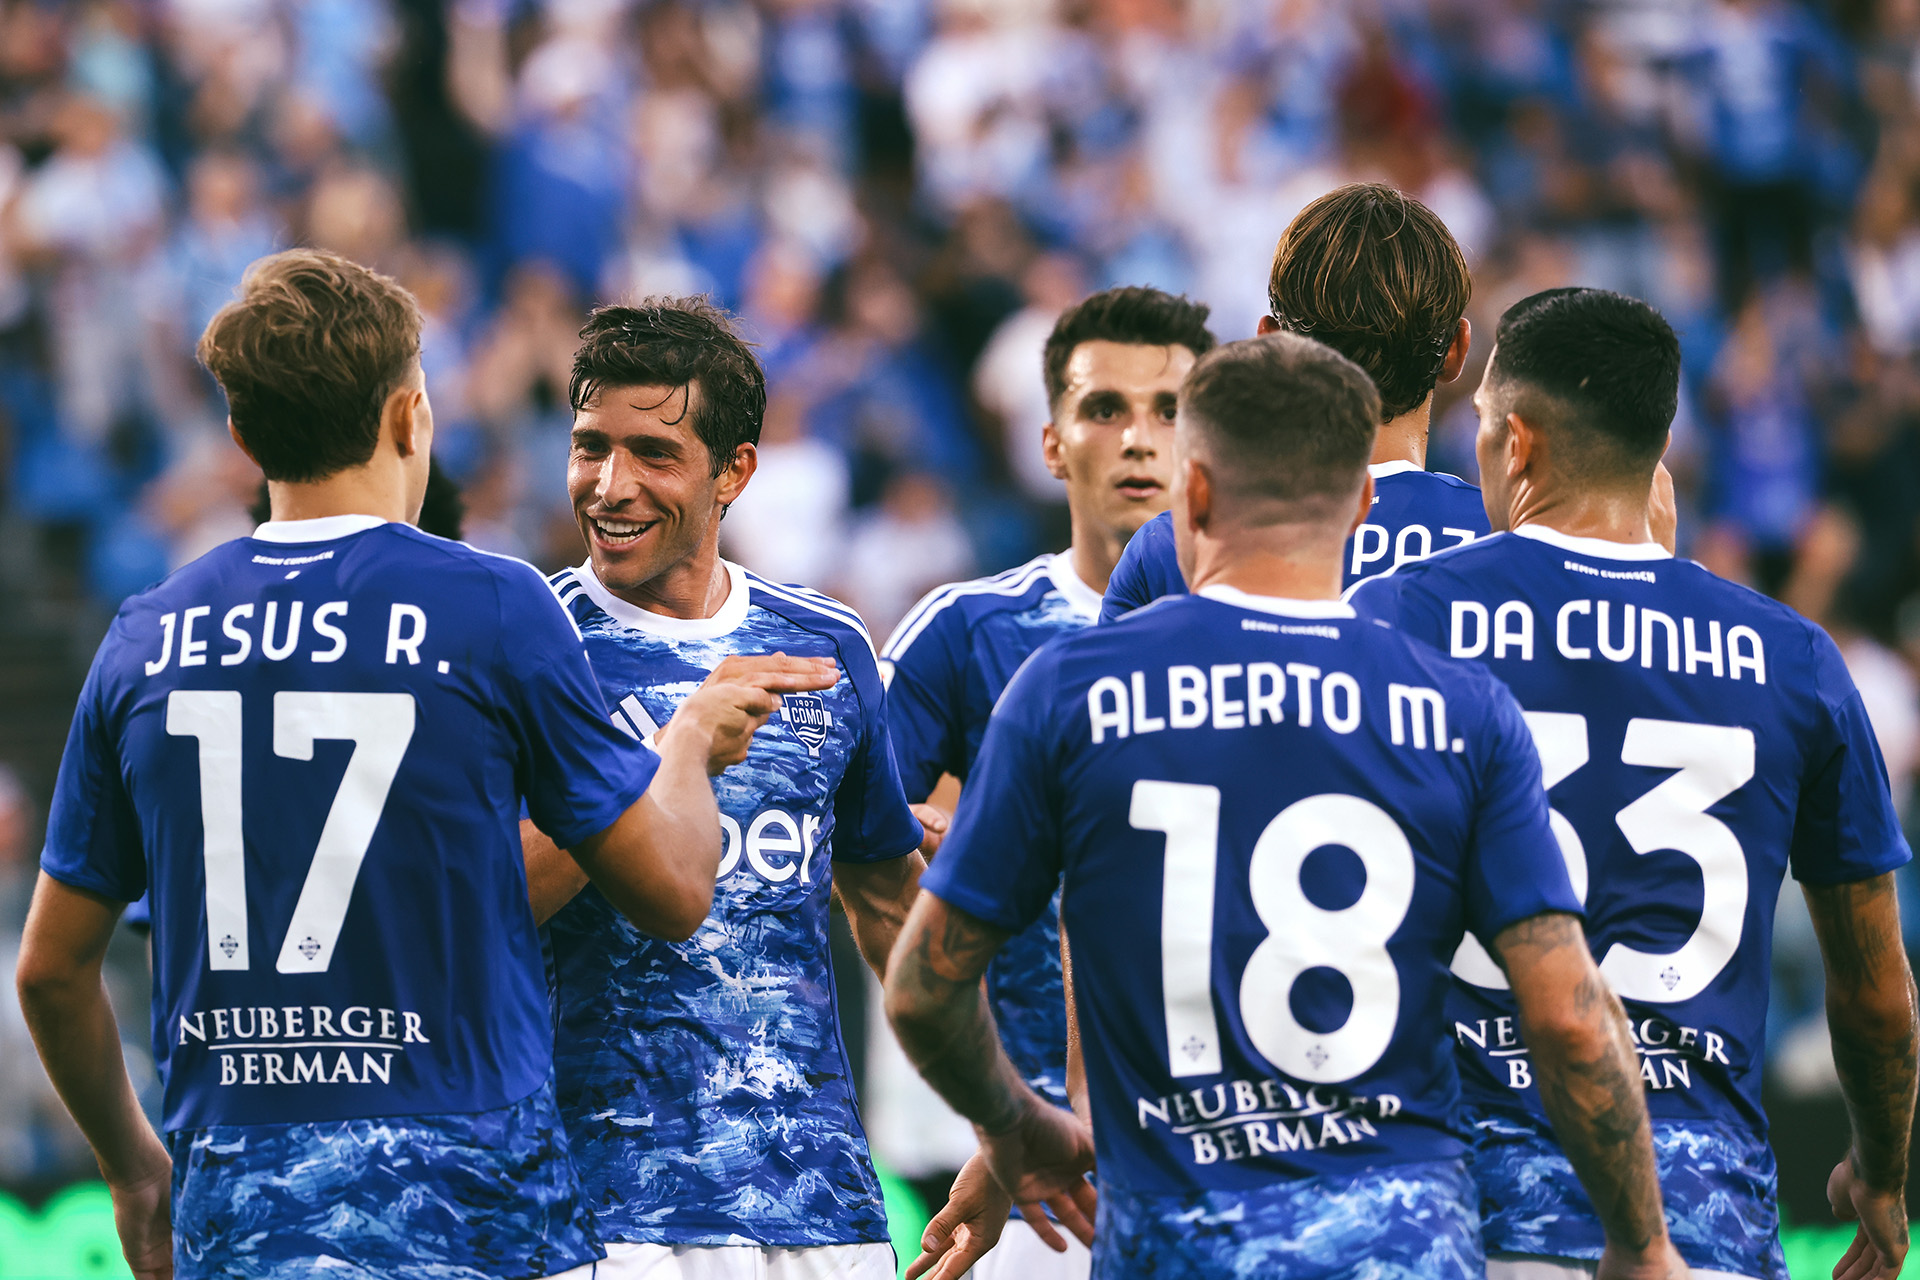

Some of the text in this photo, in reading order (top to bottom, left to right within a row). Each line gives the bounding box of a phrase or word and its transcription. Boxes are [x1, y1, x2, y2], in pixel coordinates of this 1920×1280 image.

[144, 600, 450, 677] JESUS R.
[1450, 599, 1766, 685] DA CUNHA
[791, 706, 823, 726] COMO
[795, 699, 814, 707] 1907
[1087, 661, 1465, 753] ALBERTO M.
[165, 690, 416, 974] 17
[1128, 779, 1416, 1084] 18
[178, 1006, 430, 1045] NEUBERGER
[1454, 1016, 1731, 1065] NEGER
[219, 1051, 393, 1086] BERMAN
[1507, 1056, 1692, 1090] BAN
[1190, 1113, 1378, 1165] BERMAN
